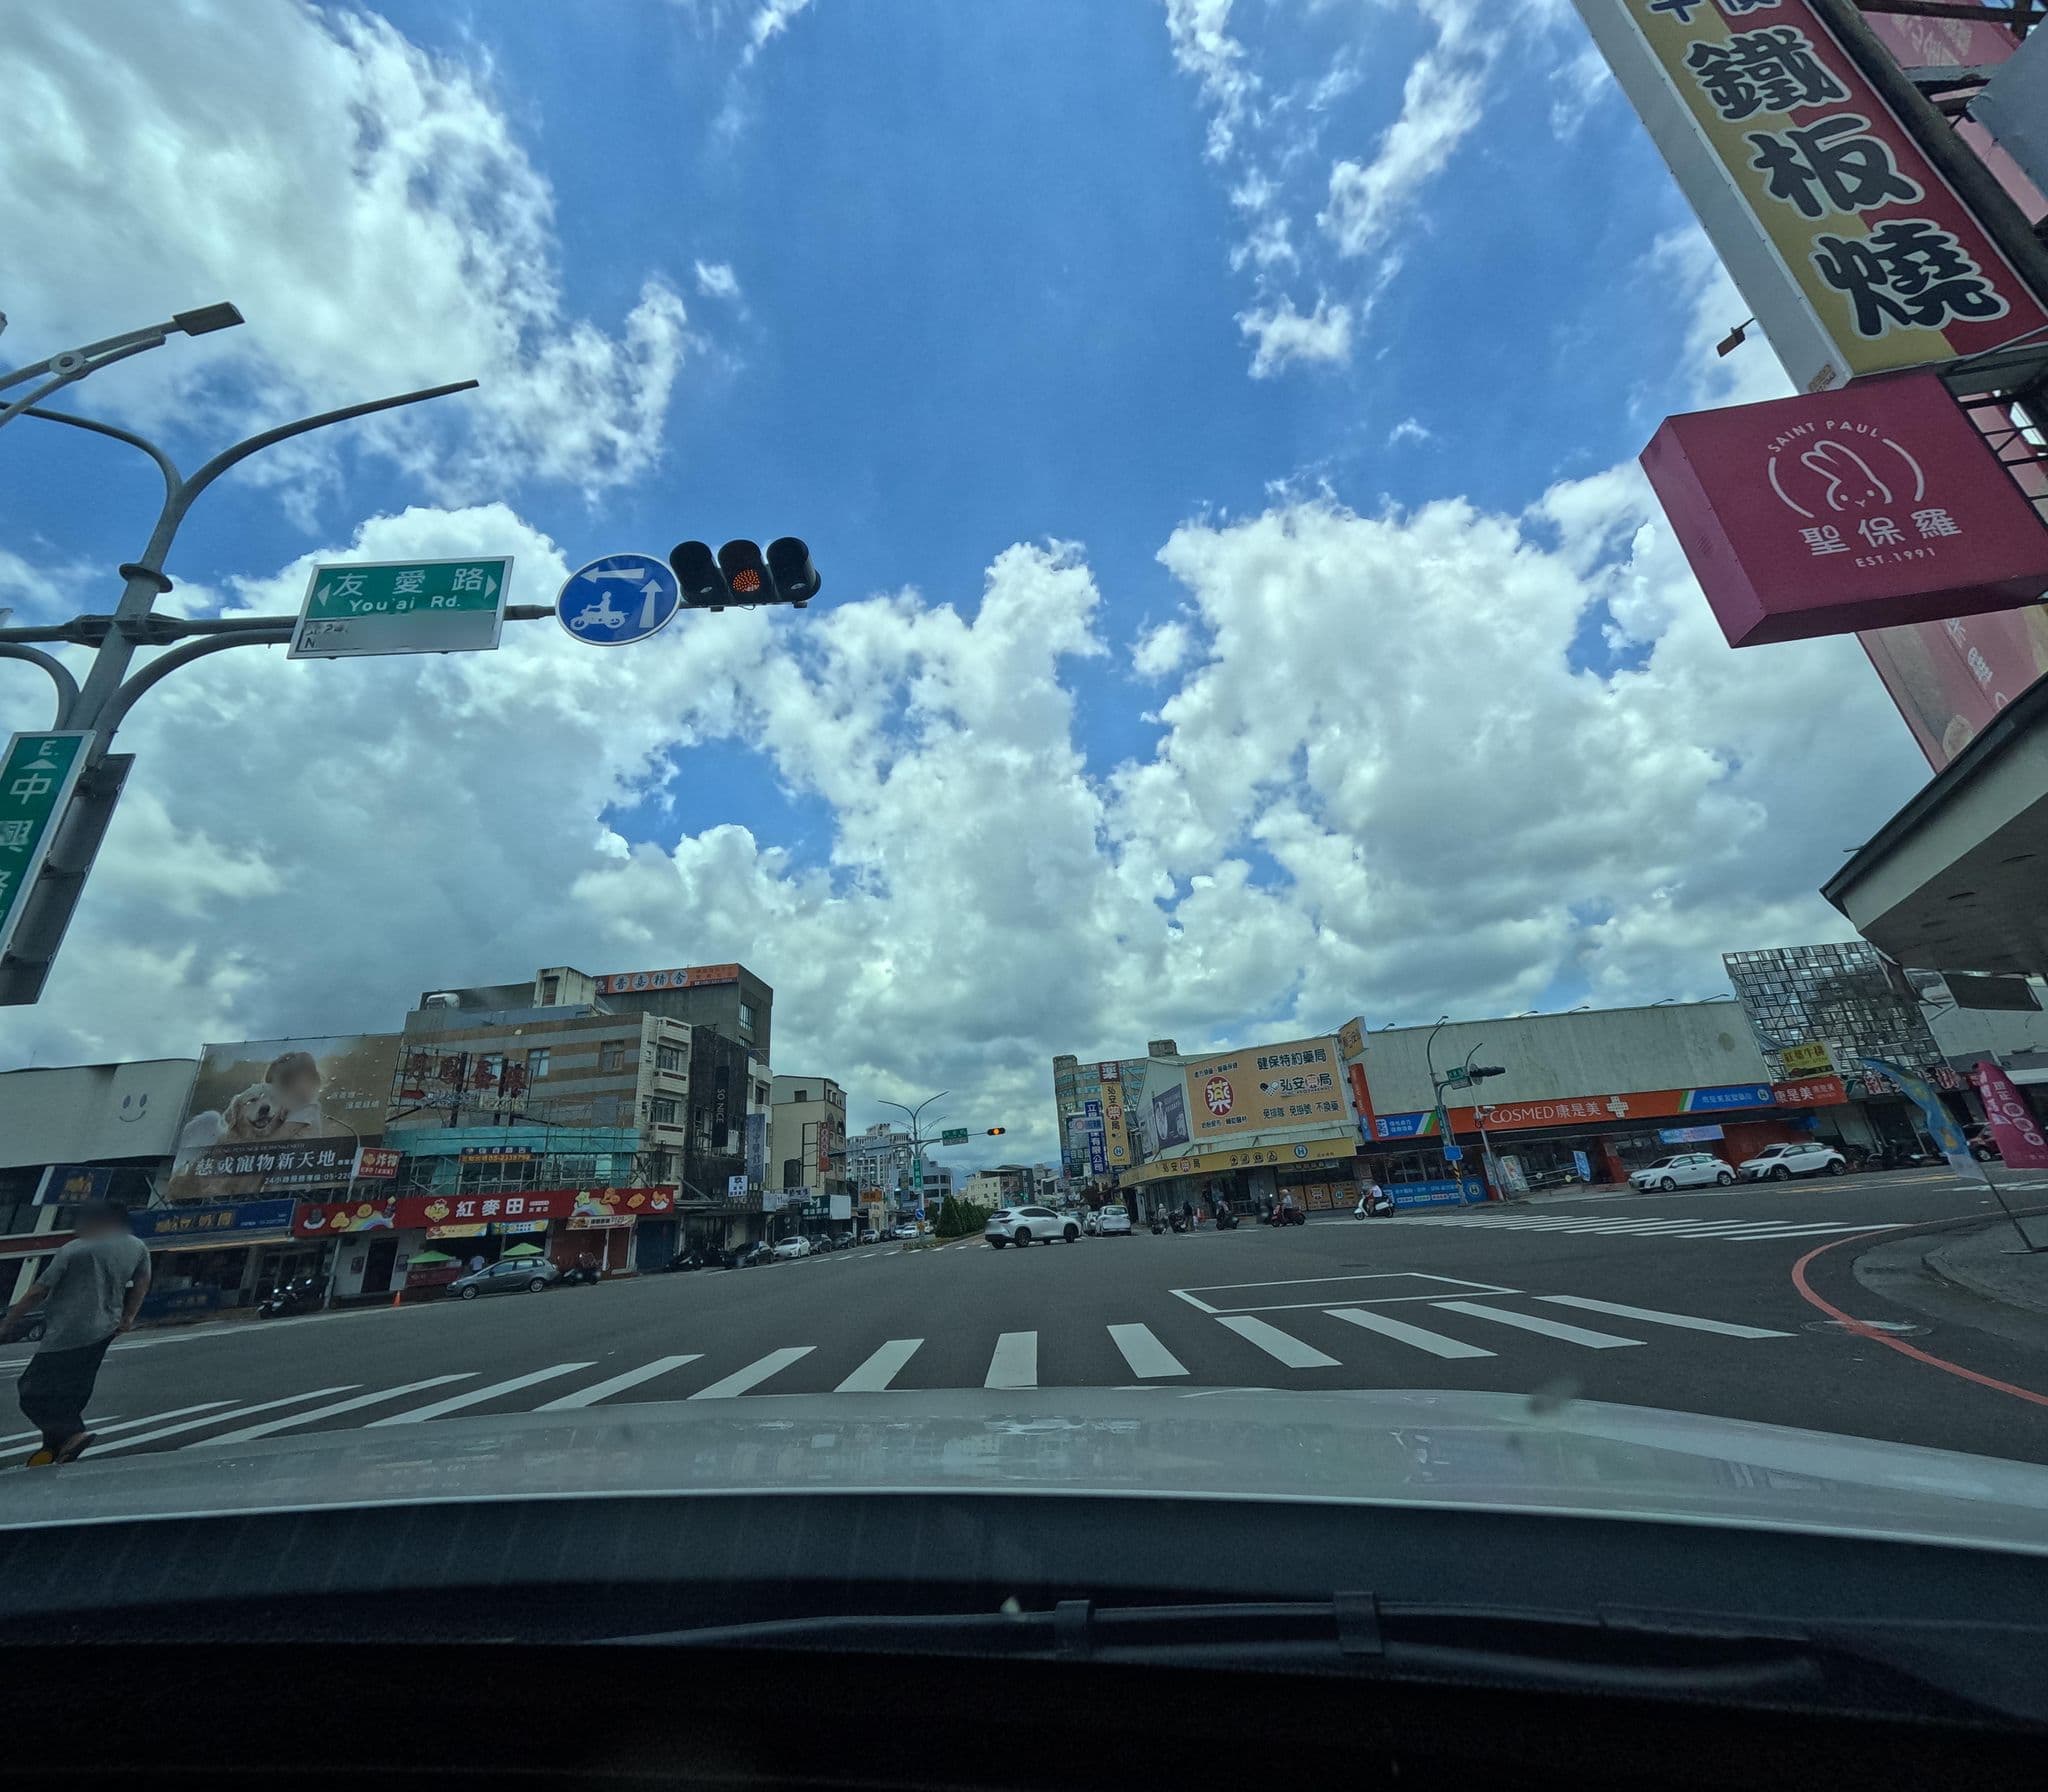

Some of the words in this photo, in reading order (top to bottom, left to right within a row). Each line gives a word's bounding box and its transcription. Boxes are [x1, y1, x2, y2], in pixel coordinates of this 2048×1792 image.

[1686, 28, 2005, 337] 鐵板燒
[1767, 422, 1816, 453] SAINT
[1825, 420, 1880, 438] PAUL
[1798, 508, 1962, 557] 聖保羅
[1855, 546, 1936, 568] EST.1991
[333, 568, 484, 597] 友愛路
[349, 597, 415, 612] You'ai
[431, 596, 461, 608] Rd.
[38, 740, 59, 756] E.
[1490, 1106, 1554, 1123] COSMED
[1556, 1101, 1601, 1119] 康是美
[456, 1198, 524, 1218] 紅麥田
